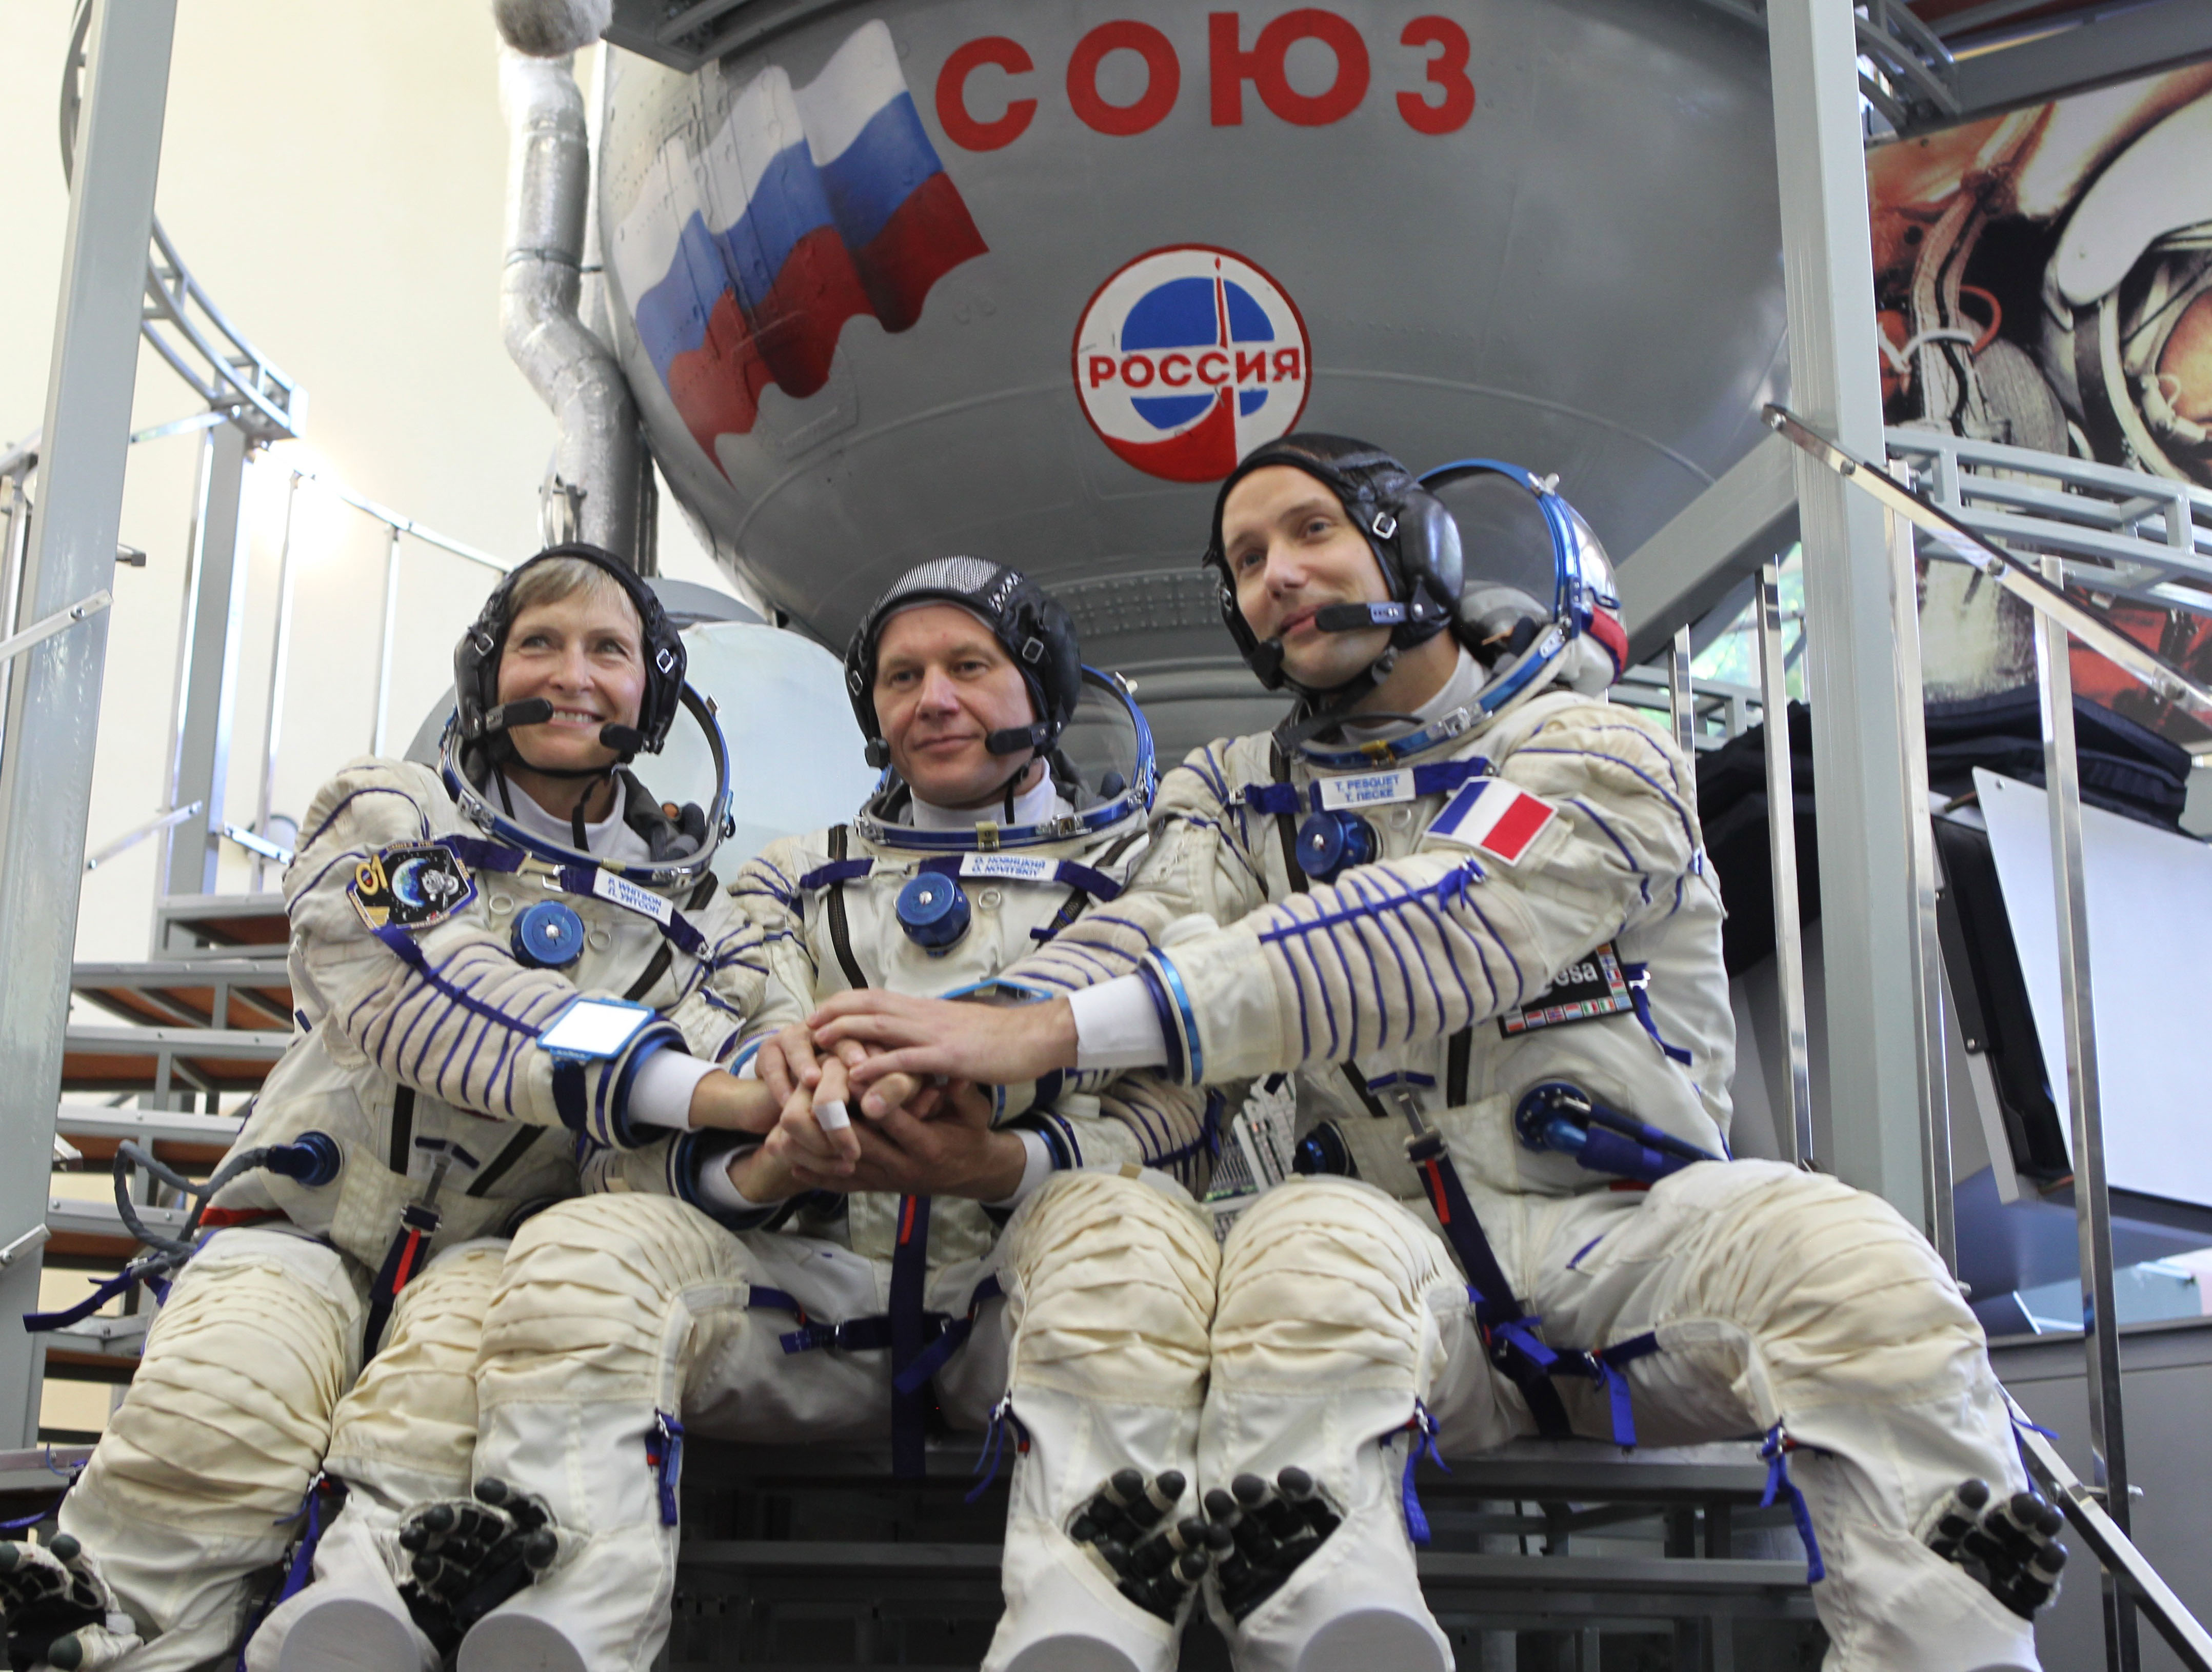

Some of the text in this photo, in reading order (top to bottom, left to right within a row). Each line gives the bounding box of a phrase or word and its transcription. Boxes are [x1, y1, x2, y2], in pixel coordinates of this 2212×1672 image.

[935, 7, 1476, 152] СОЮЗ
[1088, 347, 1302, 390] РОССИЯ
[1347, 774, 1400, 790] PESQUET
[619, 880, 662, 908] WHITSON
